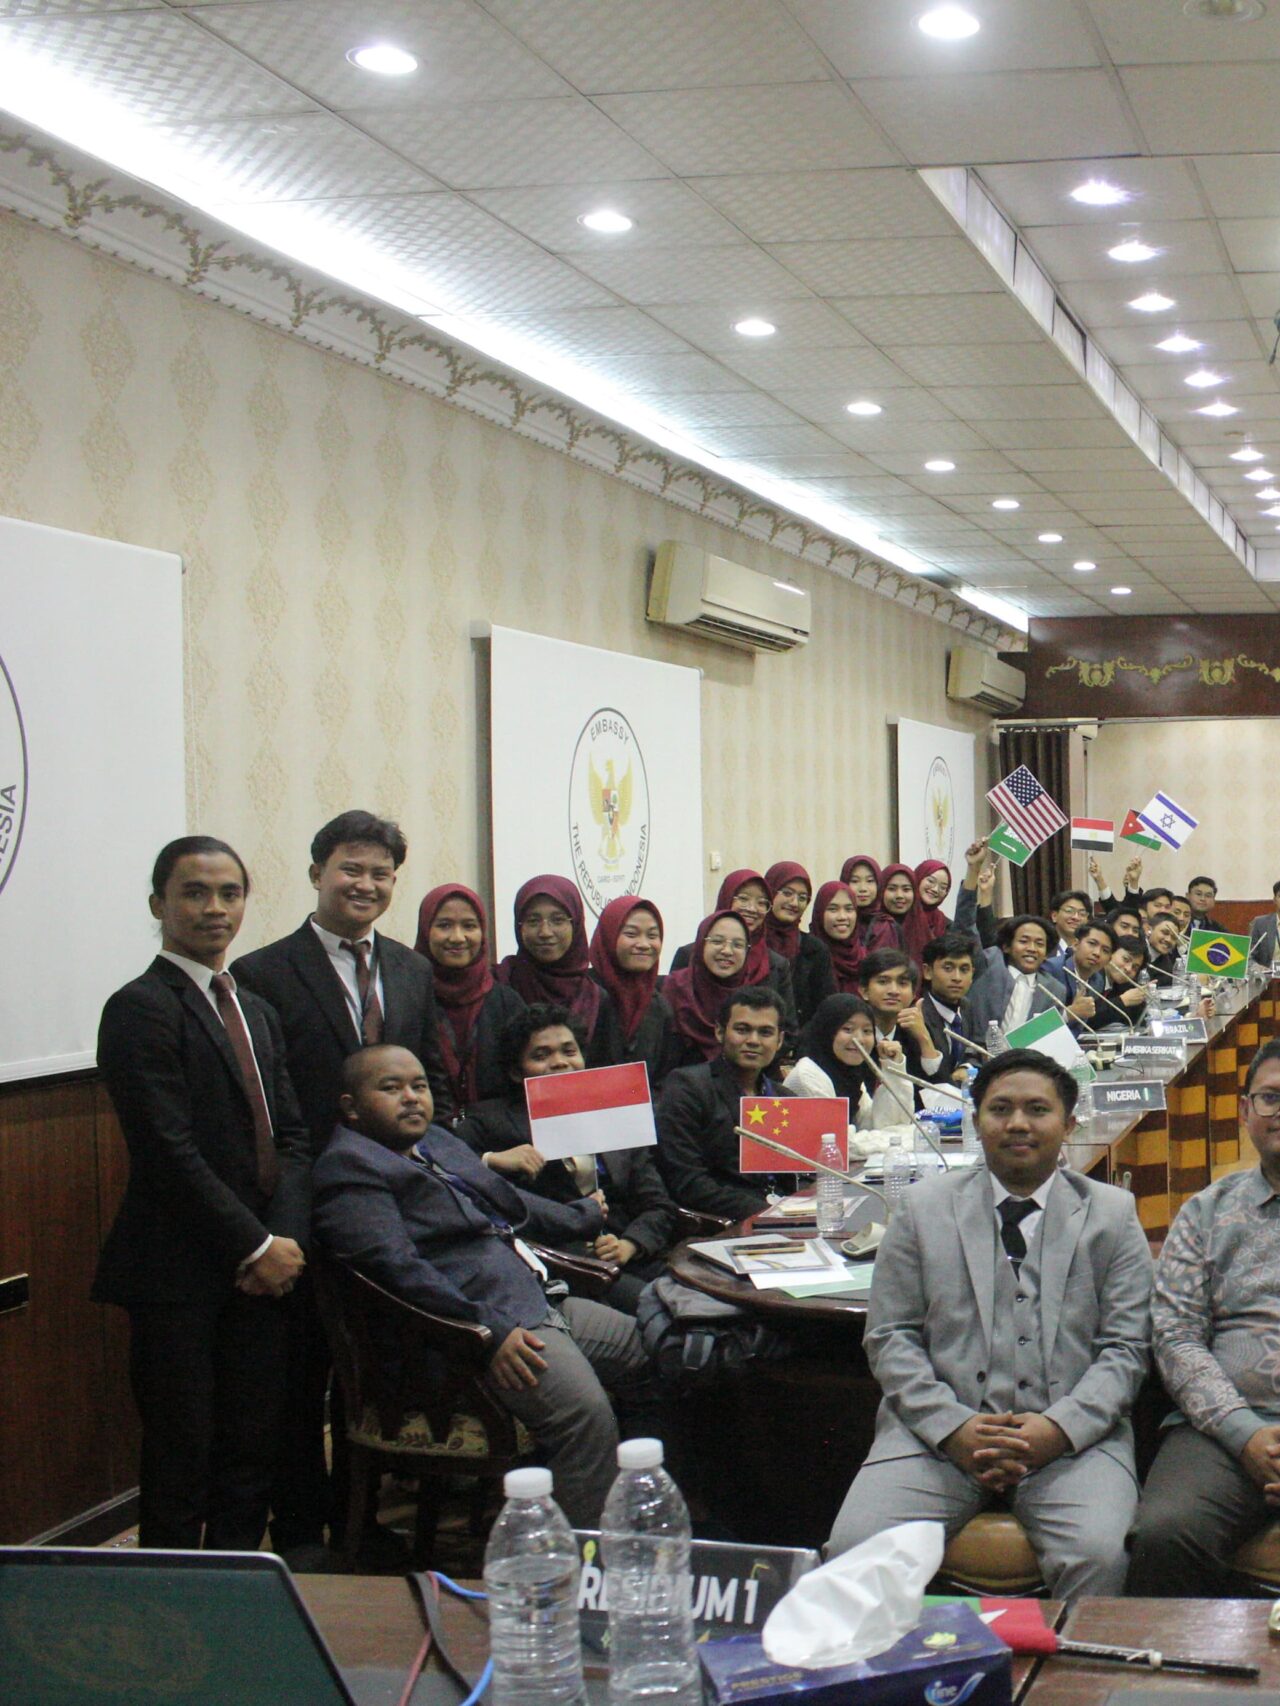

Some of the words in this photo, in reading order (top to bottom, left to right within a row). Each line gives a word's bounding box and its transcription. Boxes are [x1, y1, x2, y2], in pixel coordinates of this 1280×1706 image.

[590, 719, 629, 745] EMBASSY
[572, 823, 583, 857] THE
[1165, 1024, 1189, 1034] BRAZIL
[1106, 1089, 1141, 1102] NIGERIA
[744, 1579, 759, 1624] 1
